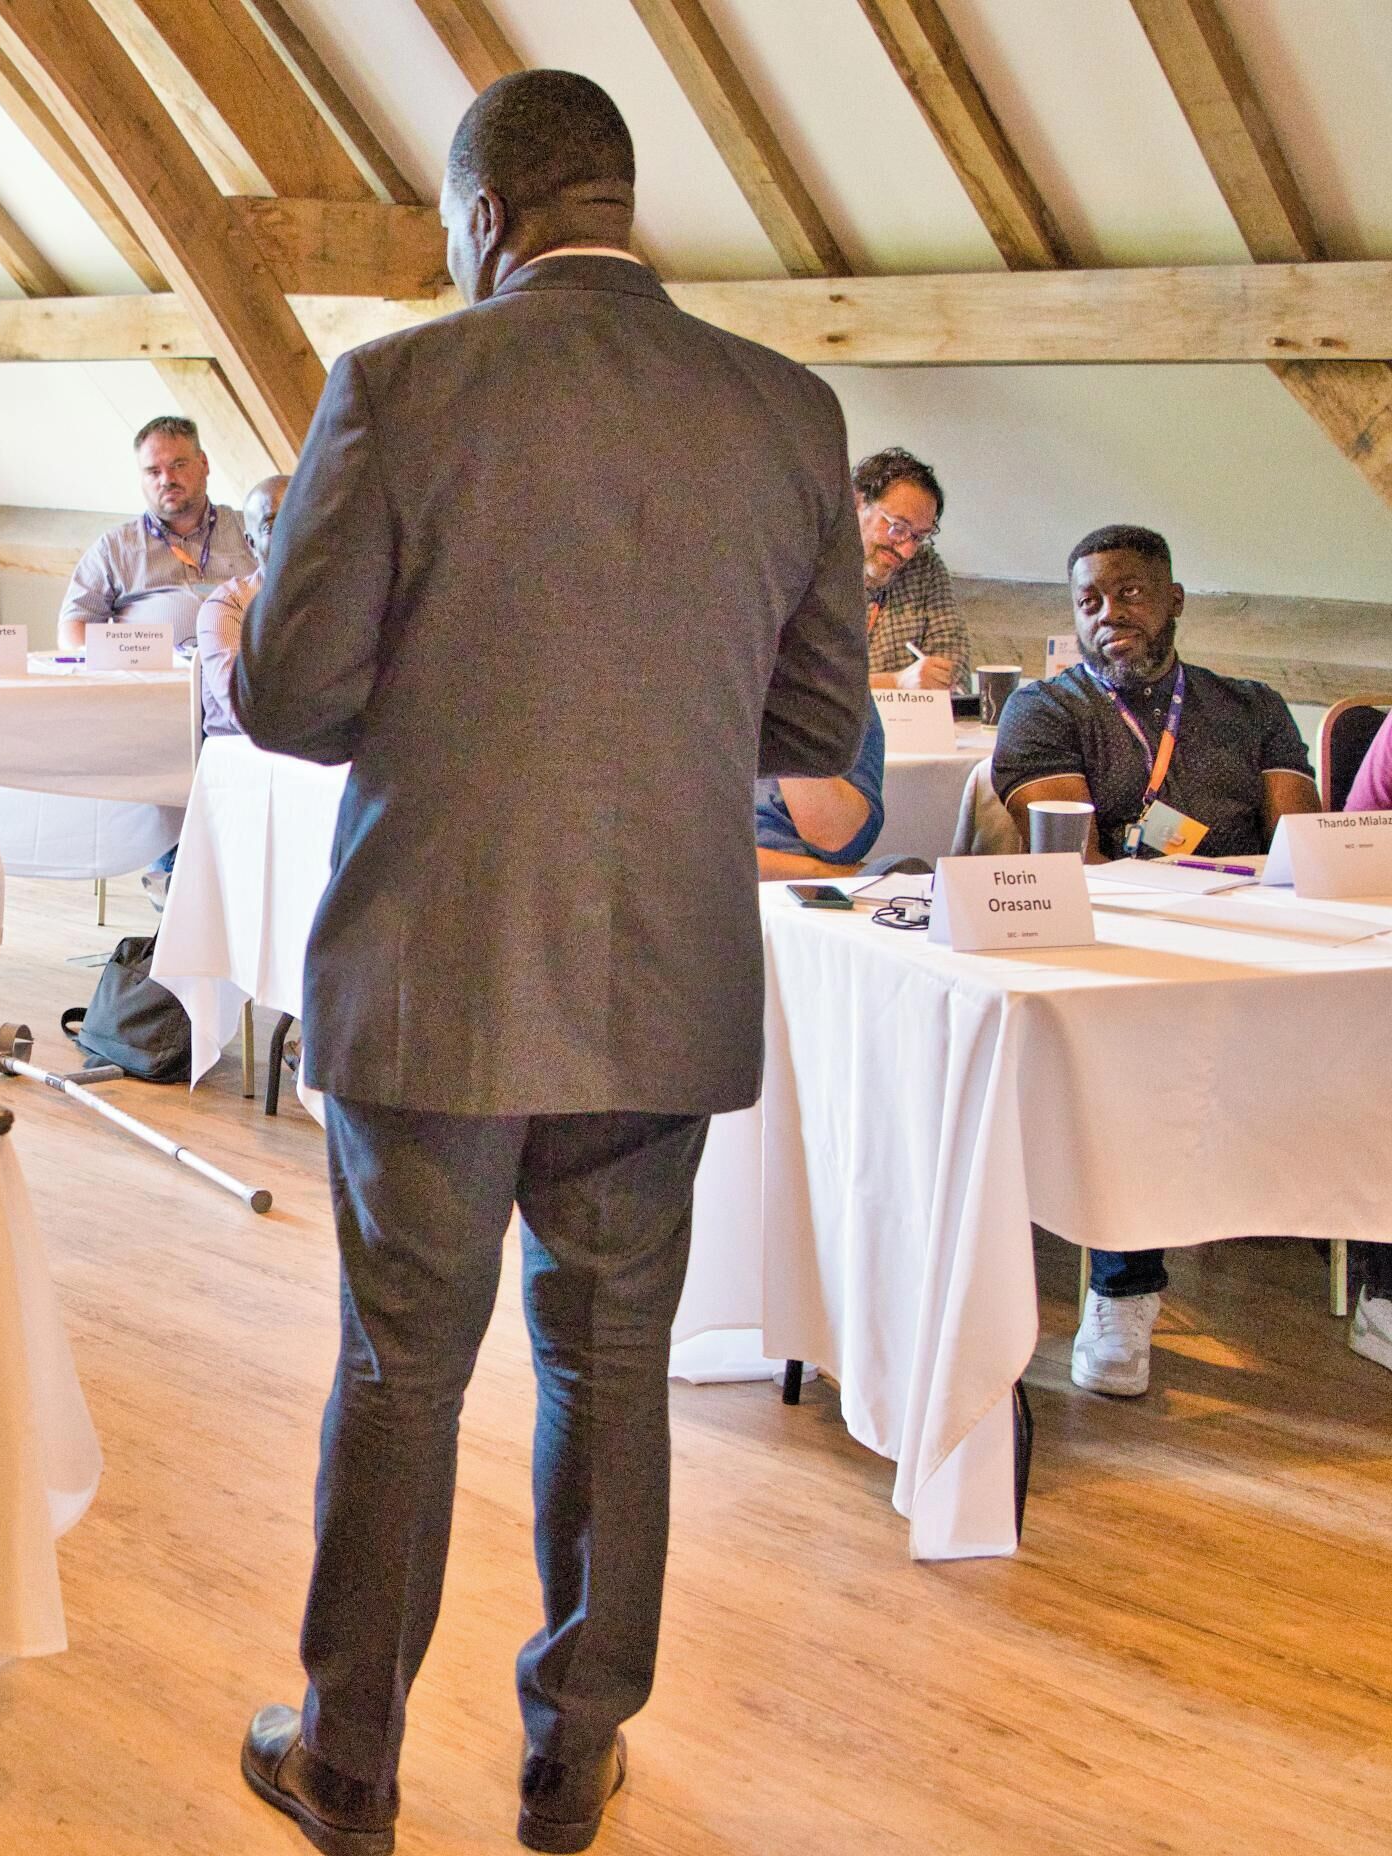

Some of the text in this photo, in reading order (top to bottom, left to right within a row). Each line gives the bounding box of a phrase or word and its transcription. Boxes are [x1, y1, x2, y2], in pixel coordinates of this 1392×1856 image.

[105, 631, 164, 639] Pastor Weires
[119, 644, 151, 652] Coetser
[875, 692, 934, 703] vid Mano
[1316, 816, 1357, 829] Thando
[993, 870, 1037, 886] Florin
[988, 898, 1052, 912] Orasanu
